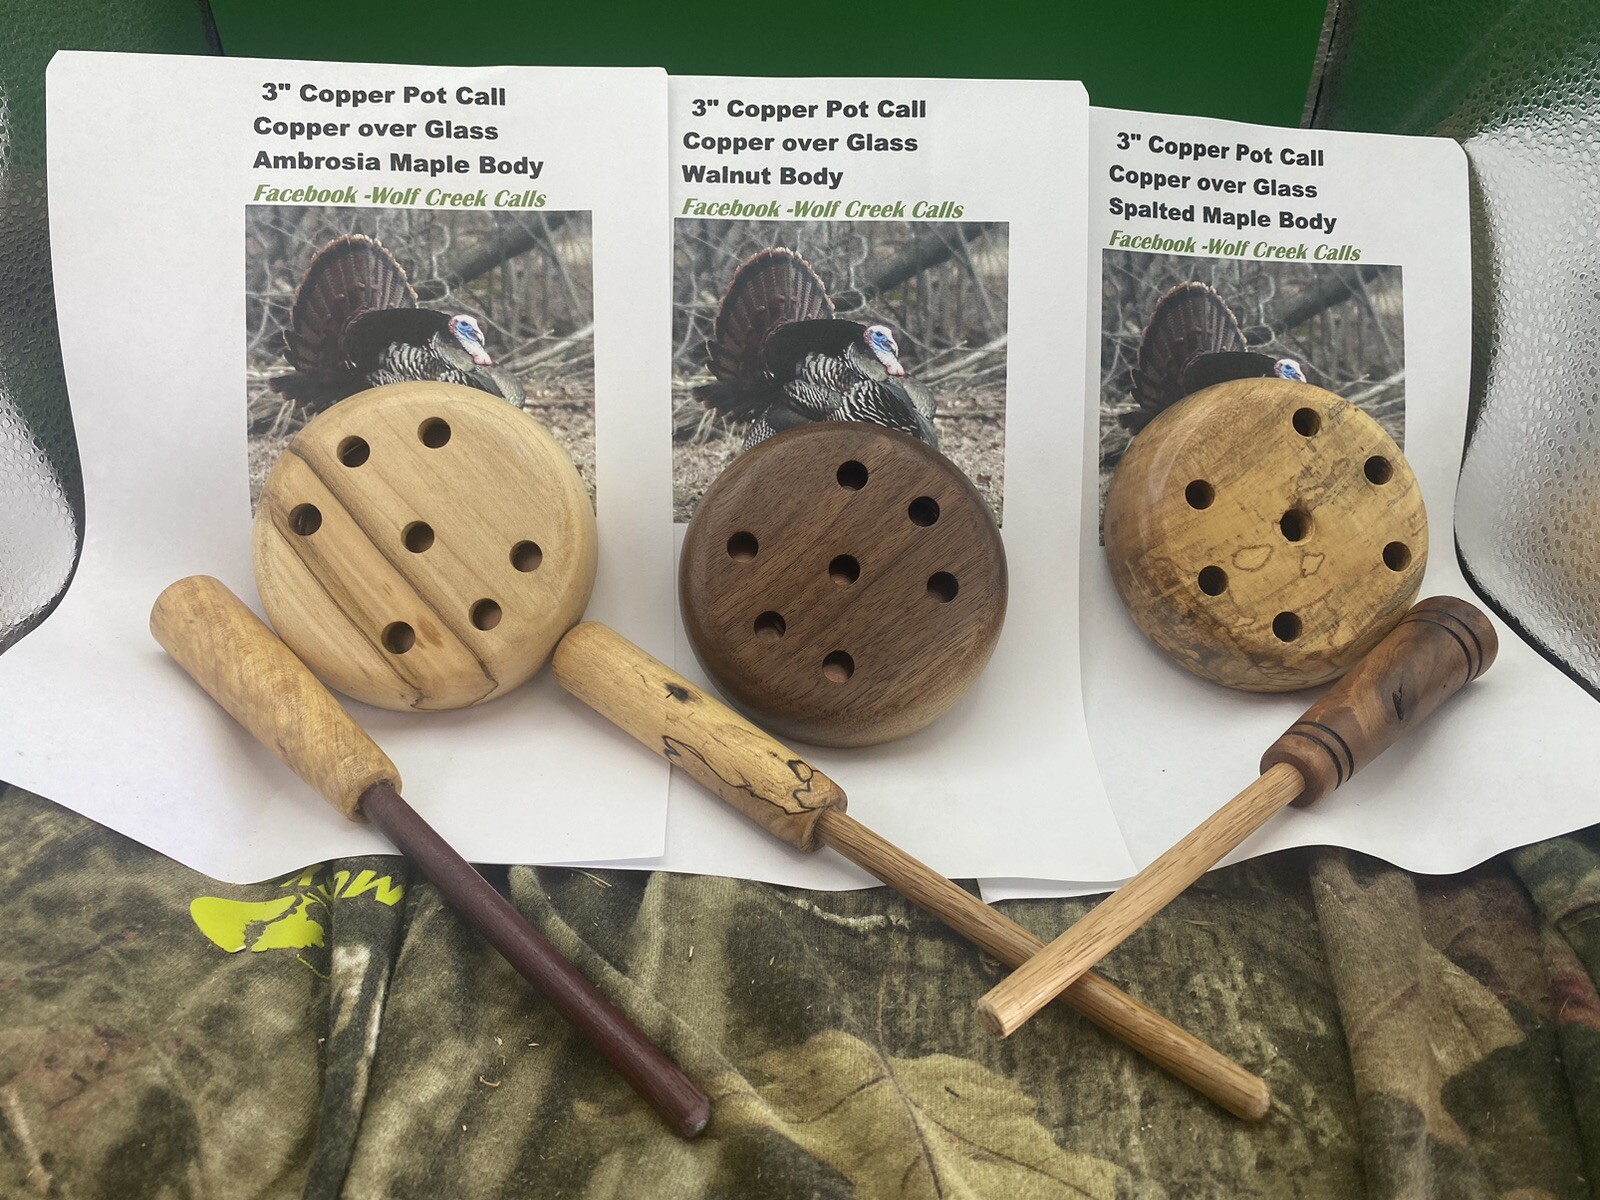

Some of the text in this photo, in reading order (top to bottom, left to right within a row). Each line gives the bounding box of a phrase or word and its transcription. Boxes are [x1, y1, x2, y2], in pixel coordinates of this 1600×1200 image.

[262, 83, 506, 107] 3" Copper Pot Call
[692, 99, 926, 122] 3" Copper Pot Call
[253, 117, 499, 140] Copper over Glass
[683, 132, 918, 154] Copper over Glass
[1117, 132, 1324, 166] 3" Copper Pot Call
[253, 151, 544, 179] Ambrosia Maple Body
[682, 165, 843, 189] Walnut Body
[1110, 165, 1317, 197] Copper over Glass
[253, 184, 547, 207] Facebook -Wolf Creek Calls
[682, 198, 964, 218] Facebook -Wolf Creek Calls
[1110, 198, 1337, 234] Spalted Maple Body
[1110, 230, 1361, 261] Facebook -Wolf Creek Calls
